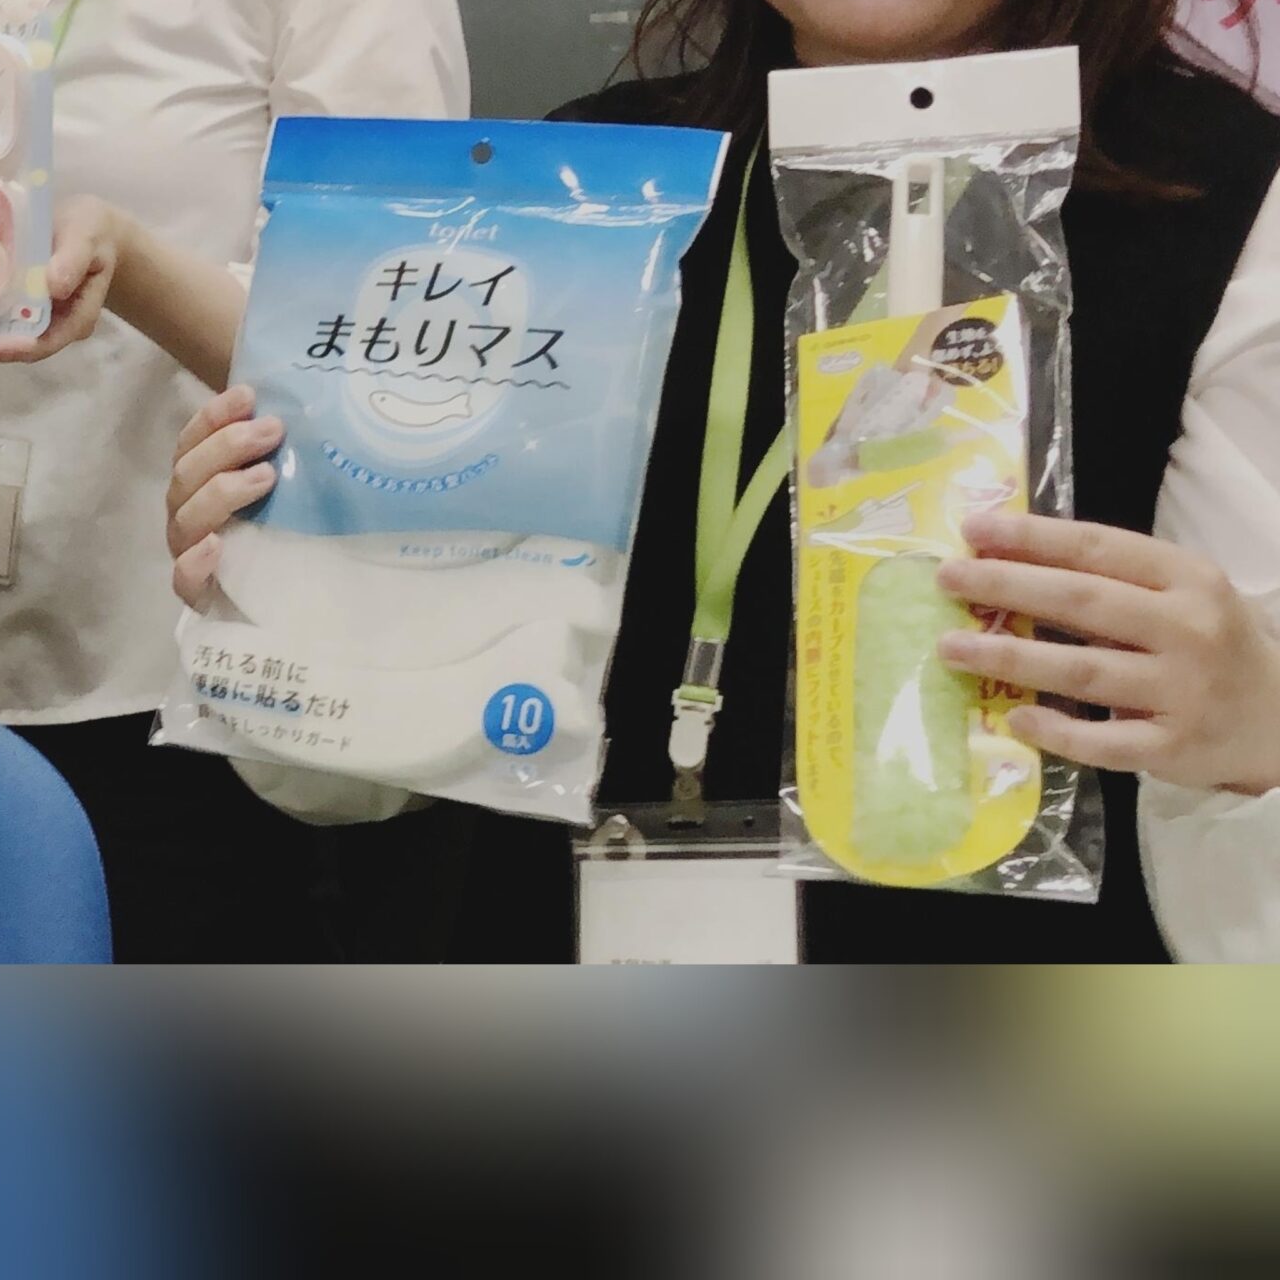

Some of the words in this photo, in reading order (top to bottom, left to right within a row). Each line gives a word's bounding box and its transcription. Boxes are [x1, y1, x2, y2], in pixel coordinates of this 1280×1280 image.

[375, 260, 517, 306] キレイ
[306, 314, 565, 370] まもりマス
[192, 644, 309, 684] 汚れる前に
[191, 672, 351, 720] 便器に貼るだけ
[501, 693, 544, 735] 10
